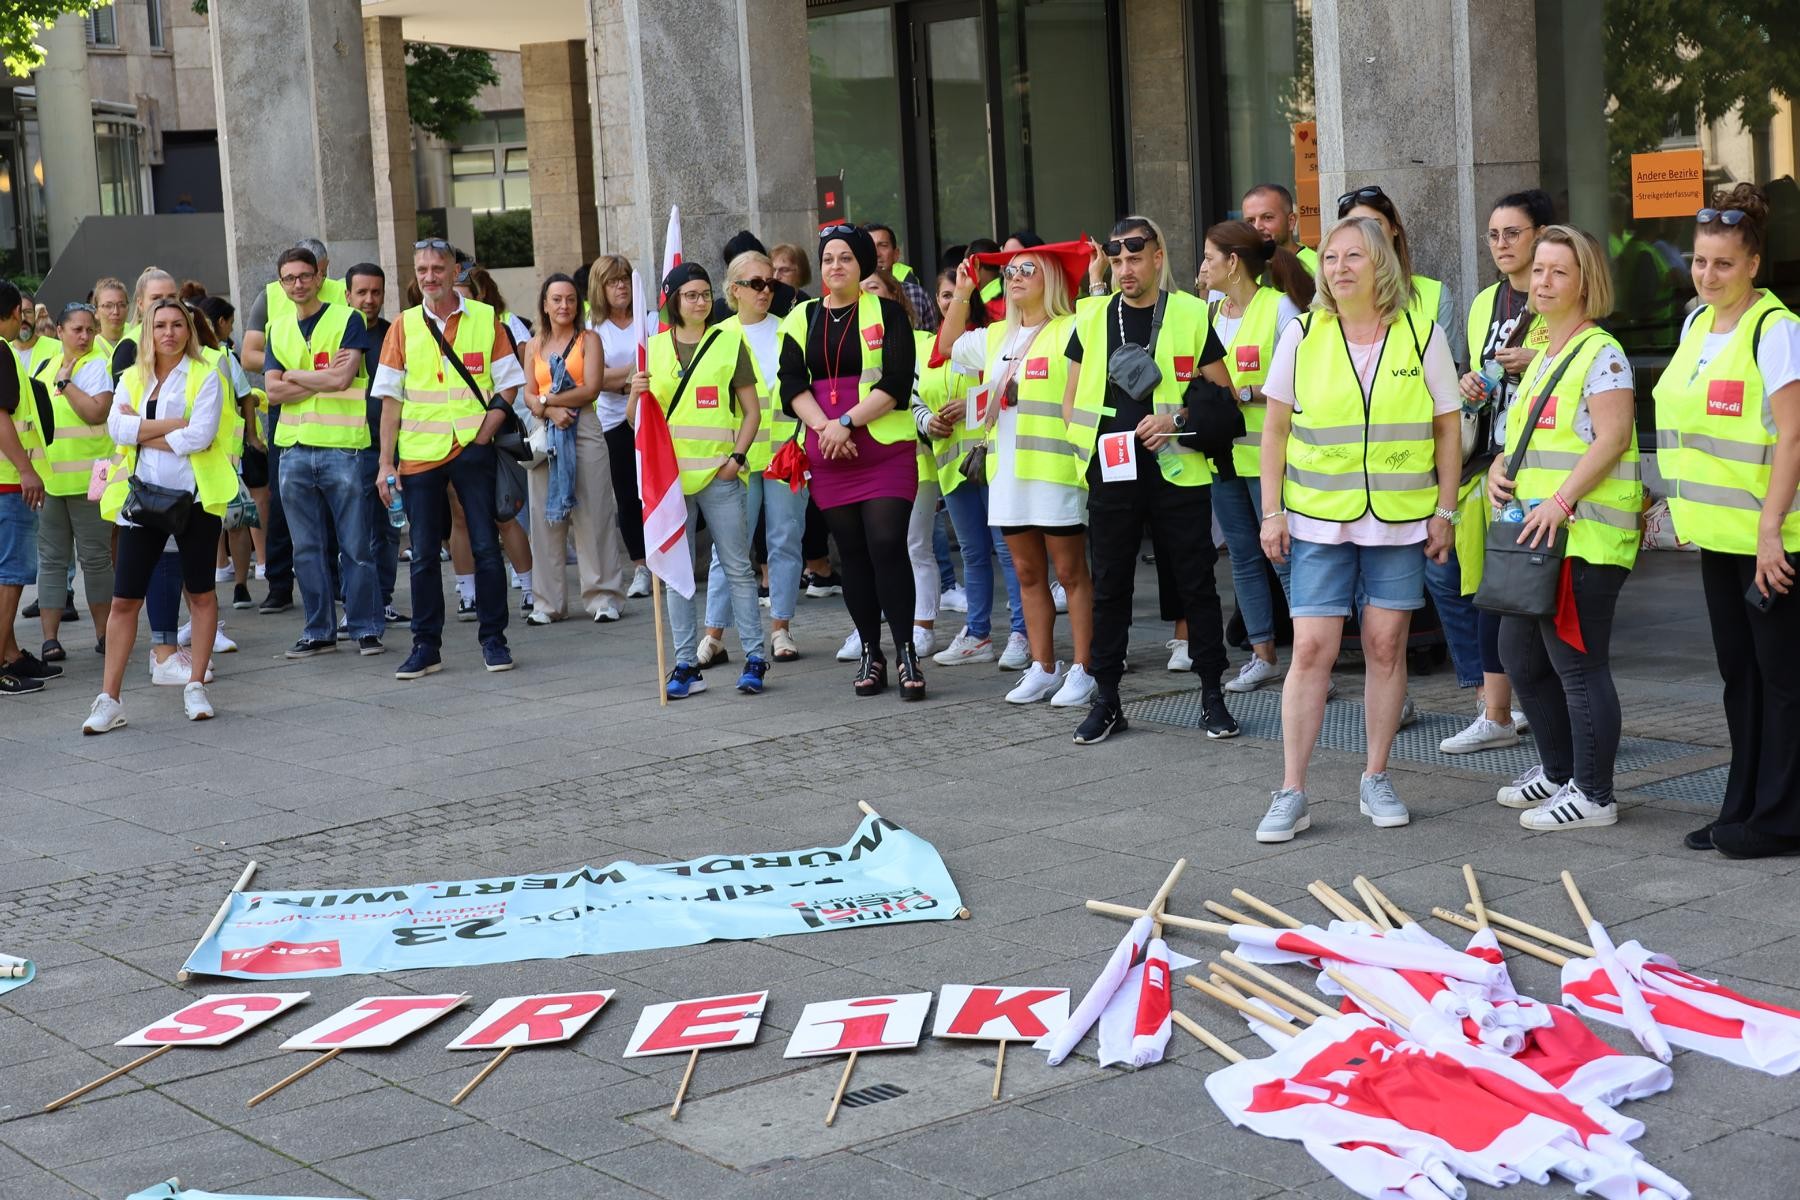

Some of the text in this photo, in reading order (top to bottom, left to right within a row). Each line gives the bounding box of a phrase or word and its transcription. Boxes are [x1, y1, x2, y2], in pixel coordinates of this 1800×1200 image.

[1637, 168, 1699, 181] Andere Bezirke
[1026, 369, 1047, 377] ver.di
[1709, 400, 1741, 413] ver.di
[1539, 416, 1555, 425] r.di
[391, 915, 507, 946] 23
